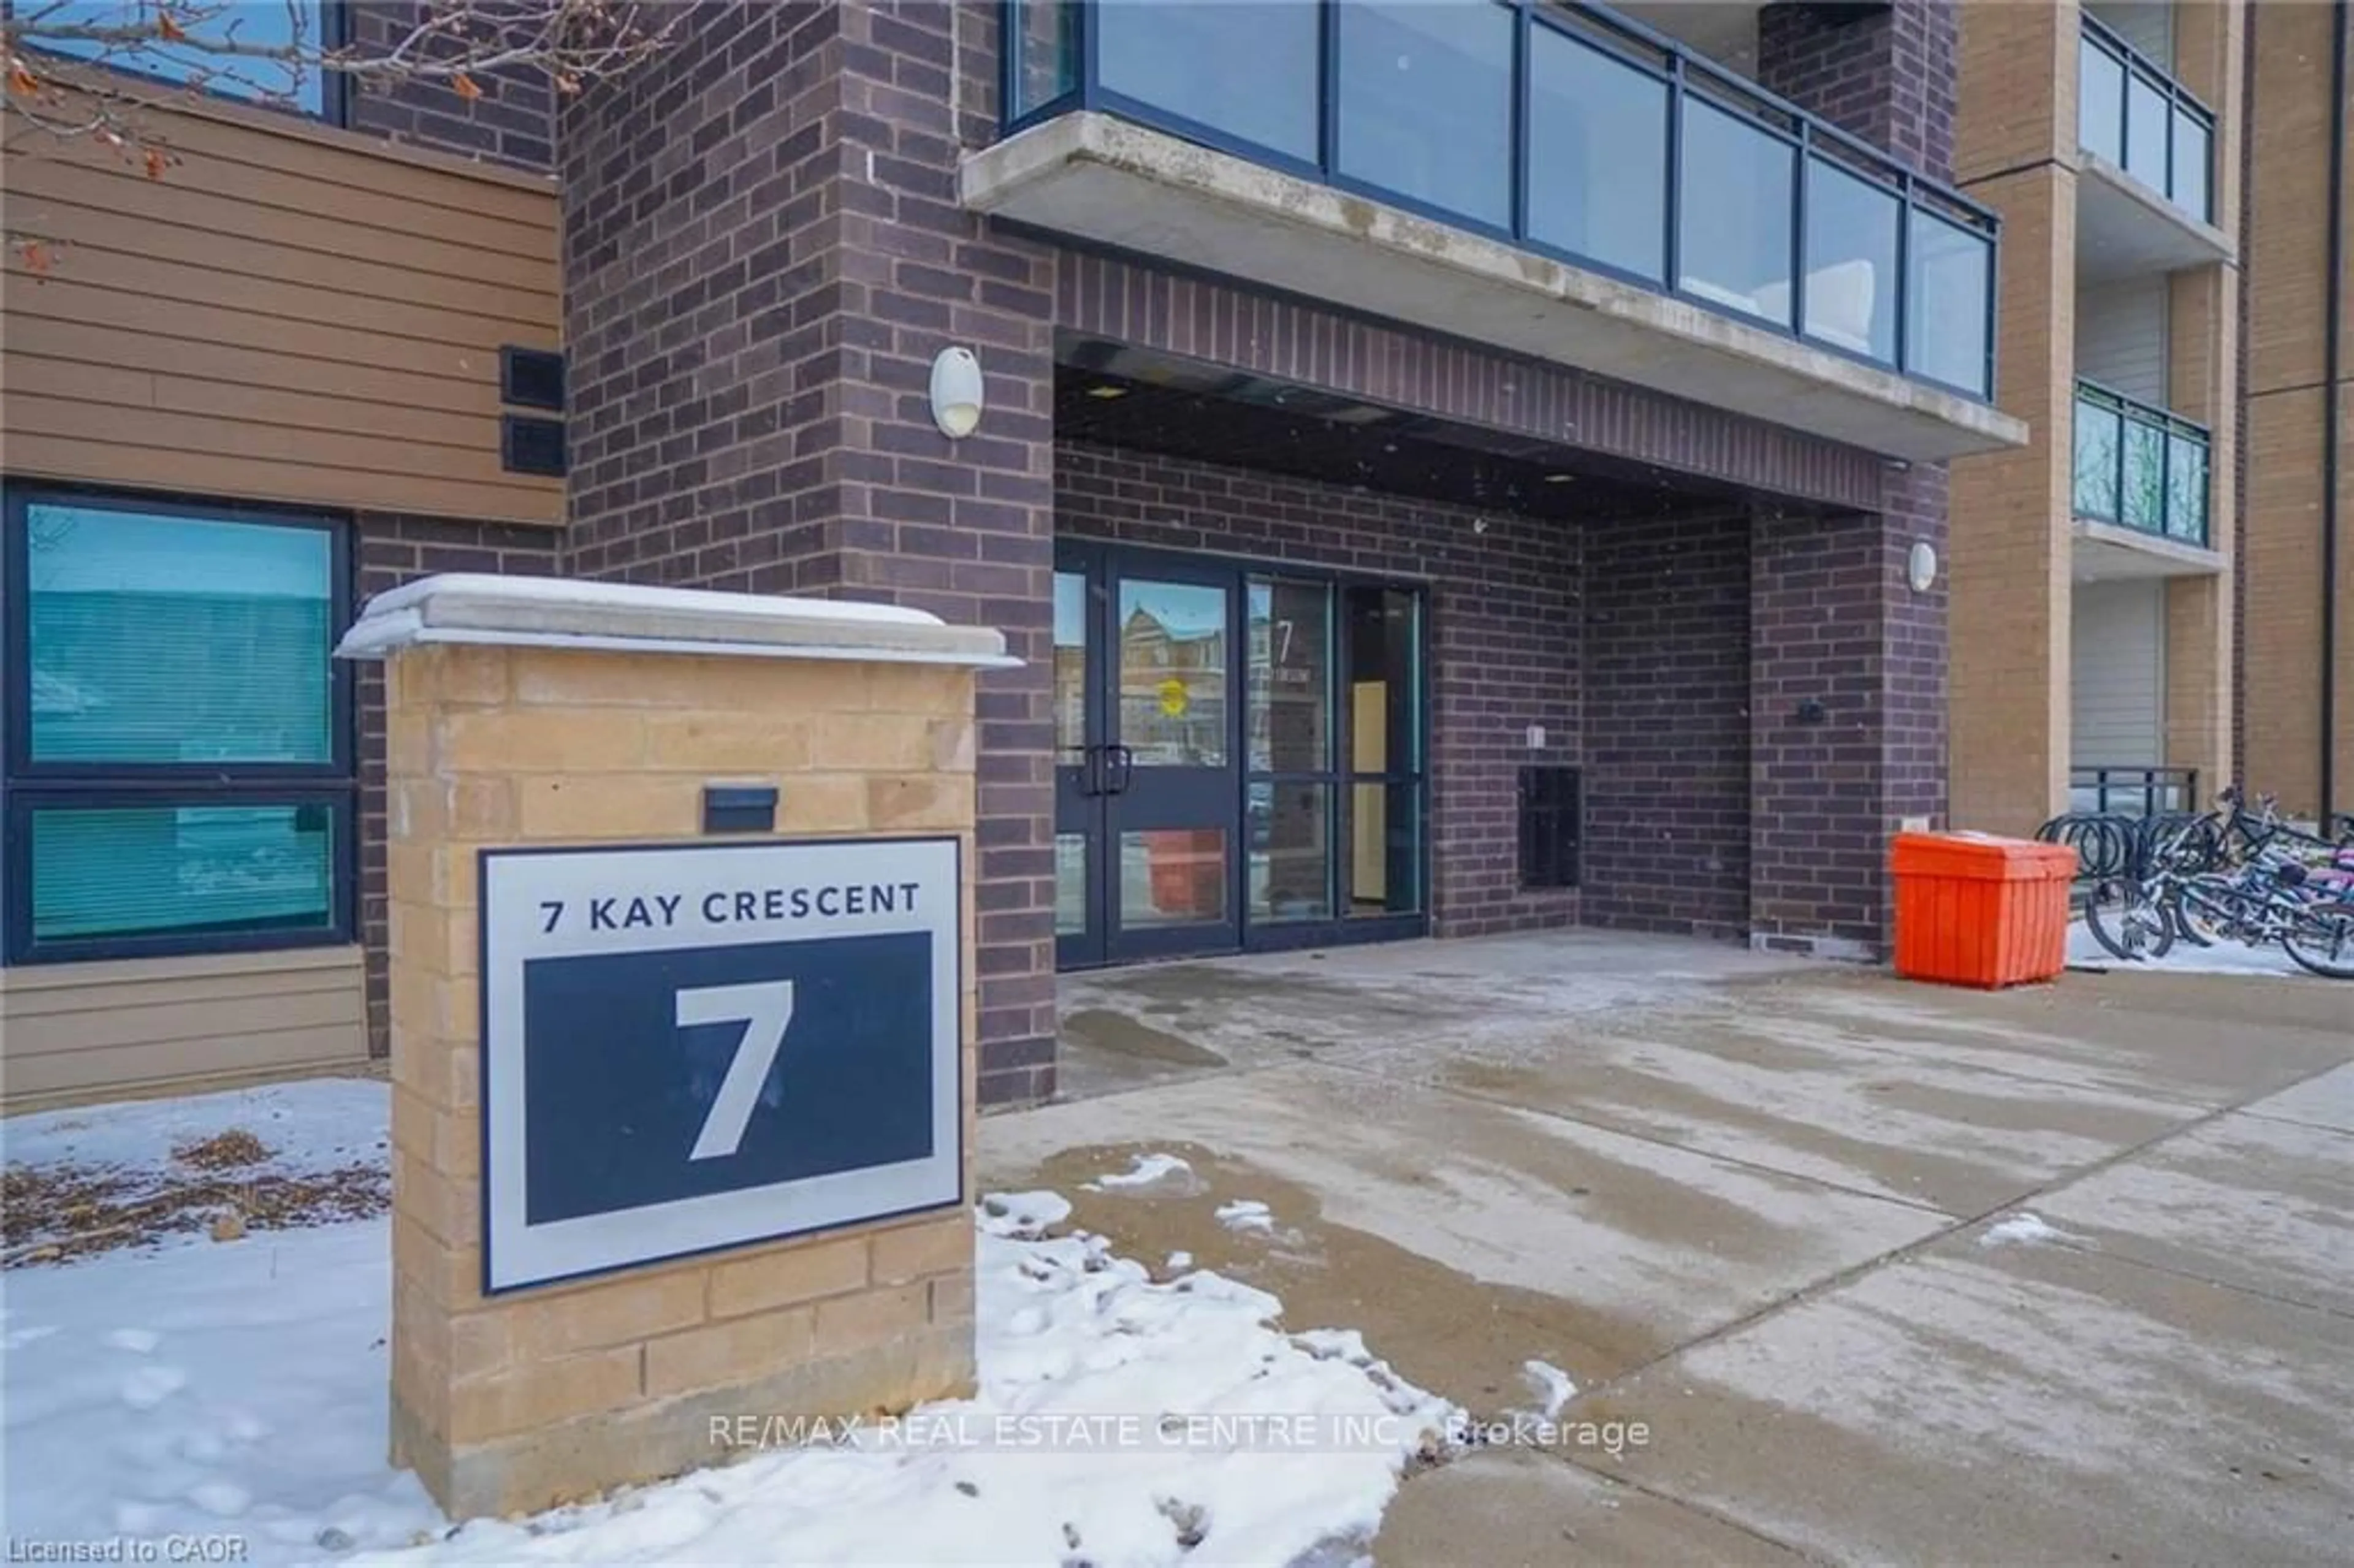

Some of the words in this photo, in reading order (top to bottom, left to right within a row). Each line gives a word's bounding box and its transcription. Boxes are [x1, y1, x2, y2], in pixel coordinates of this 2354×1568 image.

[1277, 620, 1293, 663] 7
[540, 900, 565, 932] 7
[590, 894, 682, 931] KAY
[702, 883, 921, 923] CRESCENT
[676, 980, 794, 1161] 7
